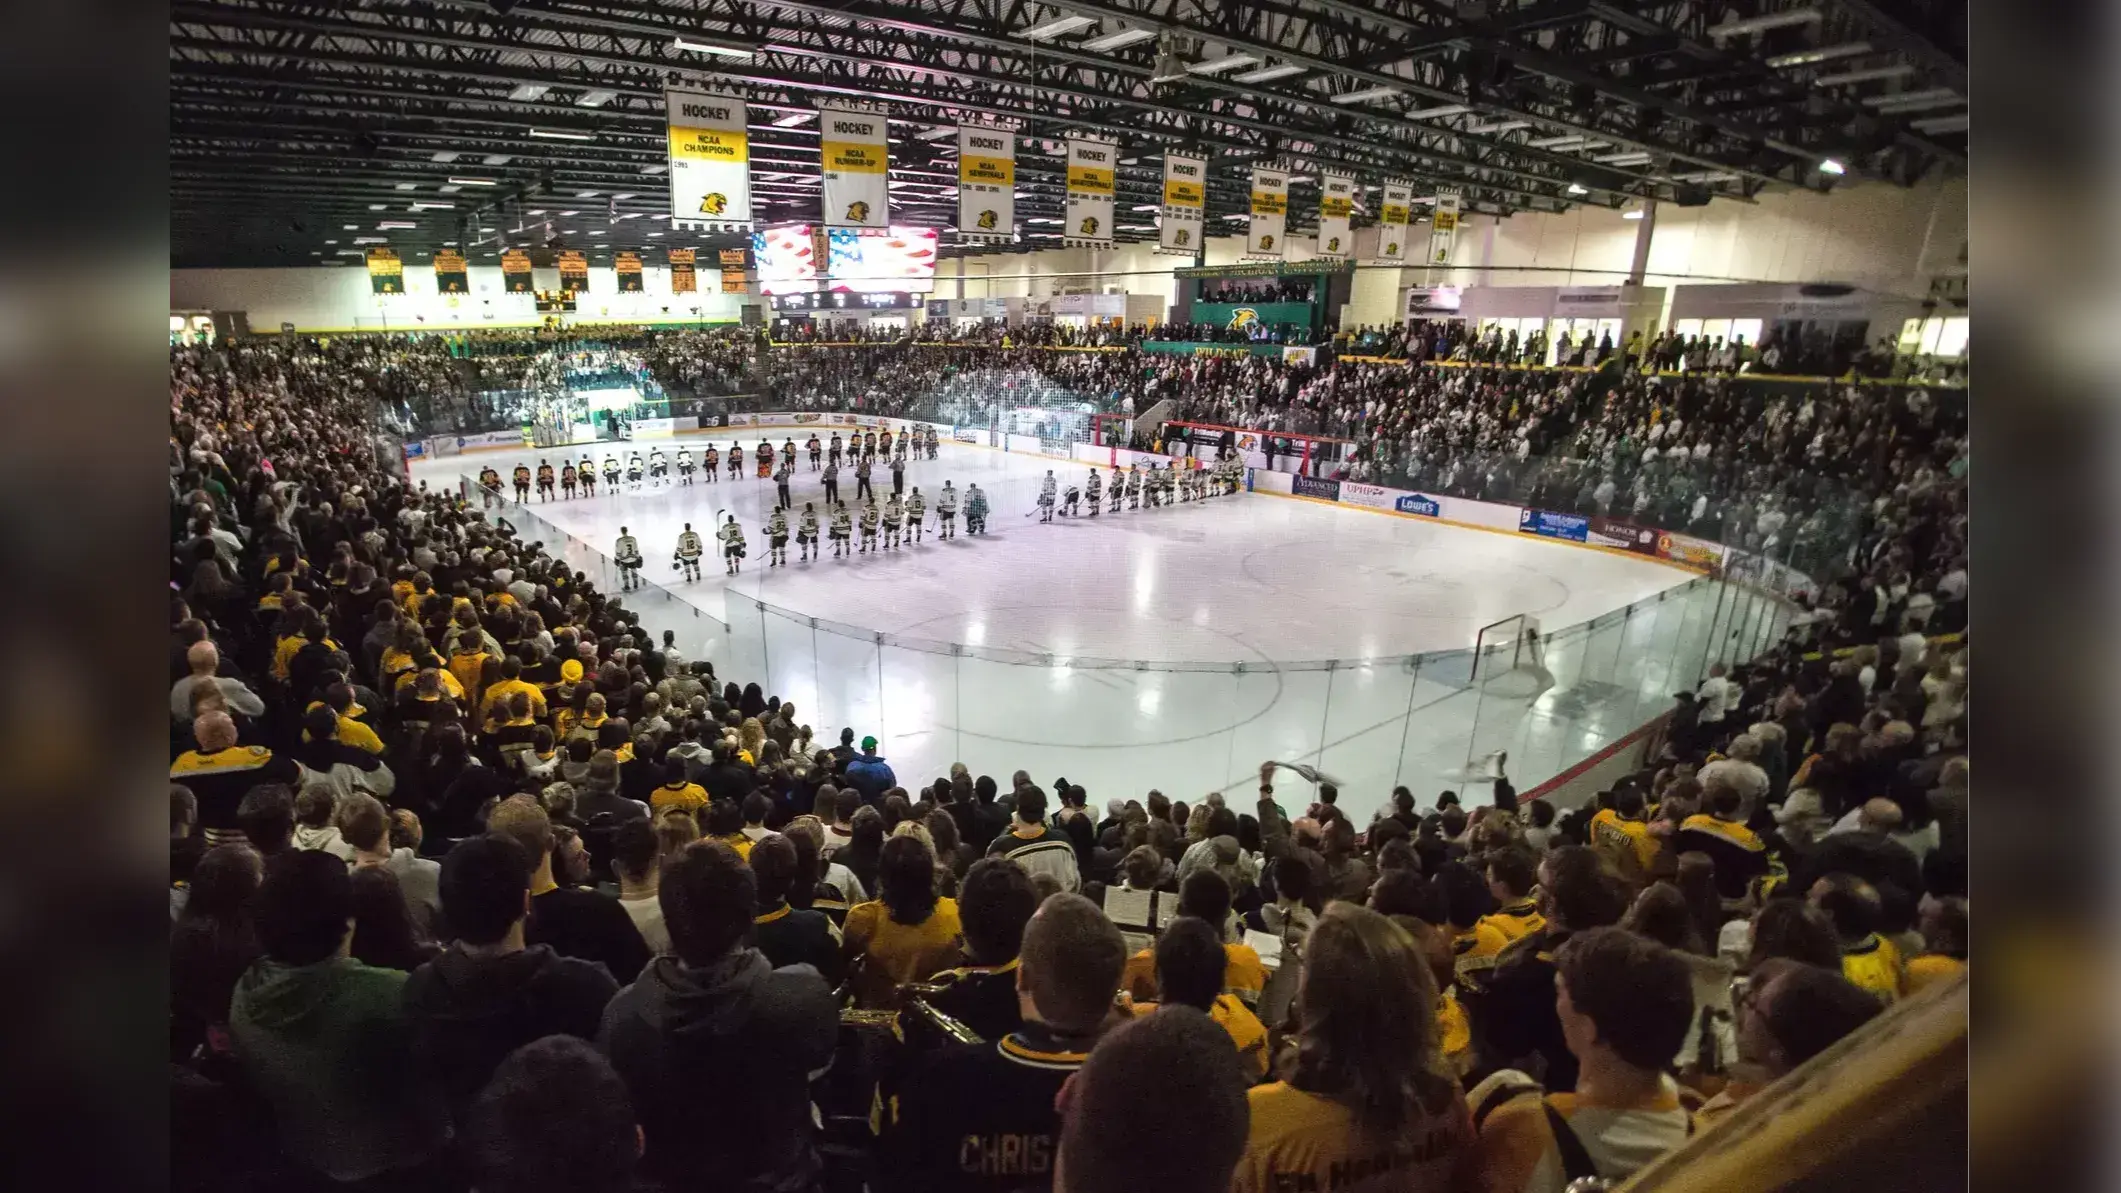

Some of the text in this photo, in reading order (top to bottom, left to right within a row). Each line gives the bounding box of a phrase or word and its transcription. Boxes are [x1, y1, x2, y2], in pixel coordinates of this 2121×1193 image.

[682, 103, 730, 120] HOCKEY
[834, 121, 874, 136] HOCKEY
[697, 135, 720, 144] NCAA
[969, 137, 1004, 150] HOCKEY
[684, 144, 734, 155] CHAMPIONS
[845, 149, 865, 158] NCAA
[1077, 149, 1106, 162] HOCKEY
[834, 157, 876, 166] RUNNER-UP
[969, 169, 1005, 179] SEMIFINALS
[1173, 164, 1197, 176] HOCKEY
[1259, 176, 1281, 187] HOCKEY
[1297, 475, 1338, 491] ADVANCED
[1347, 484, 1373, 495] UPHP
[1401, 498, 1434, 512] LOWE'S
[1605, 524, 1637, 537] HONOR
[626, 544, 632, 554] 3
[687, 540, 695, 549] 12
